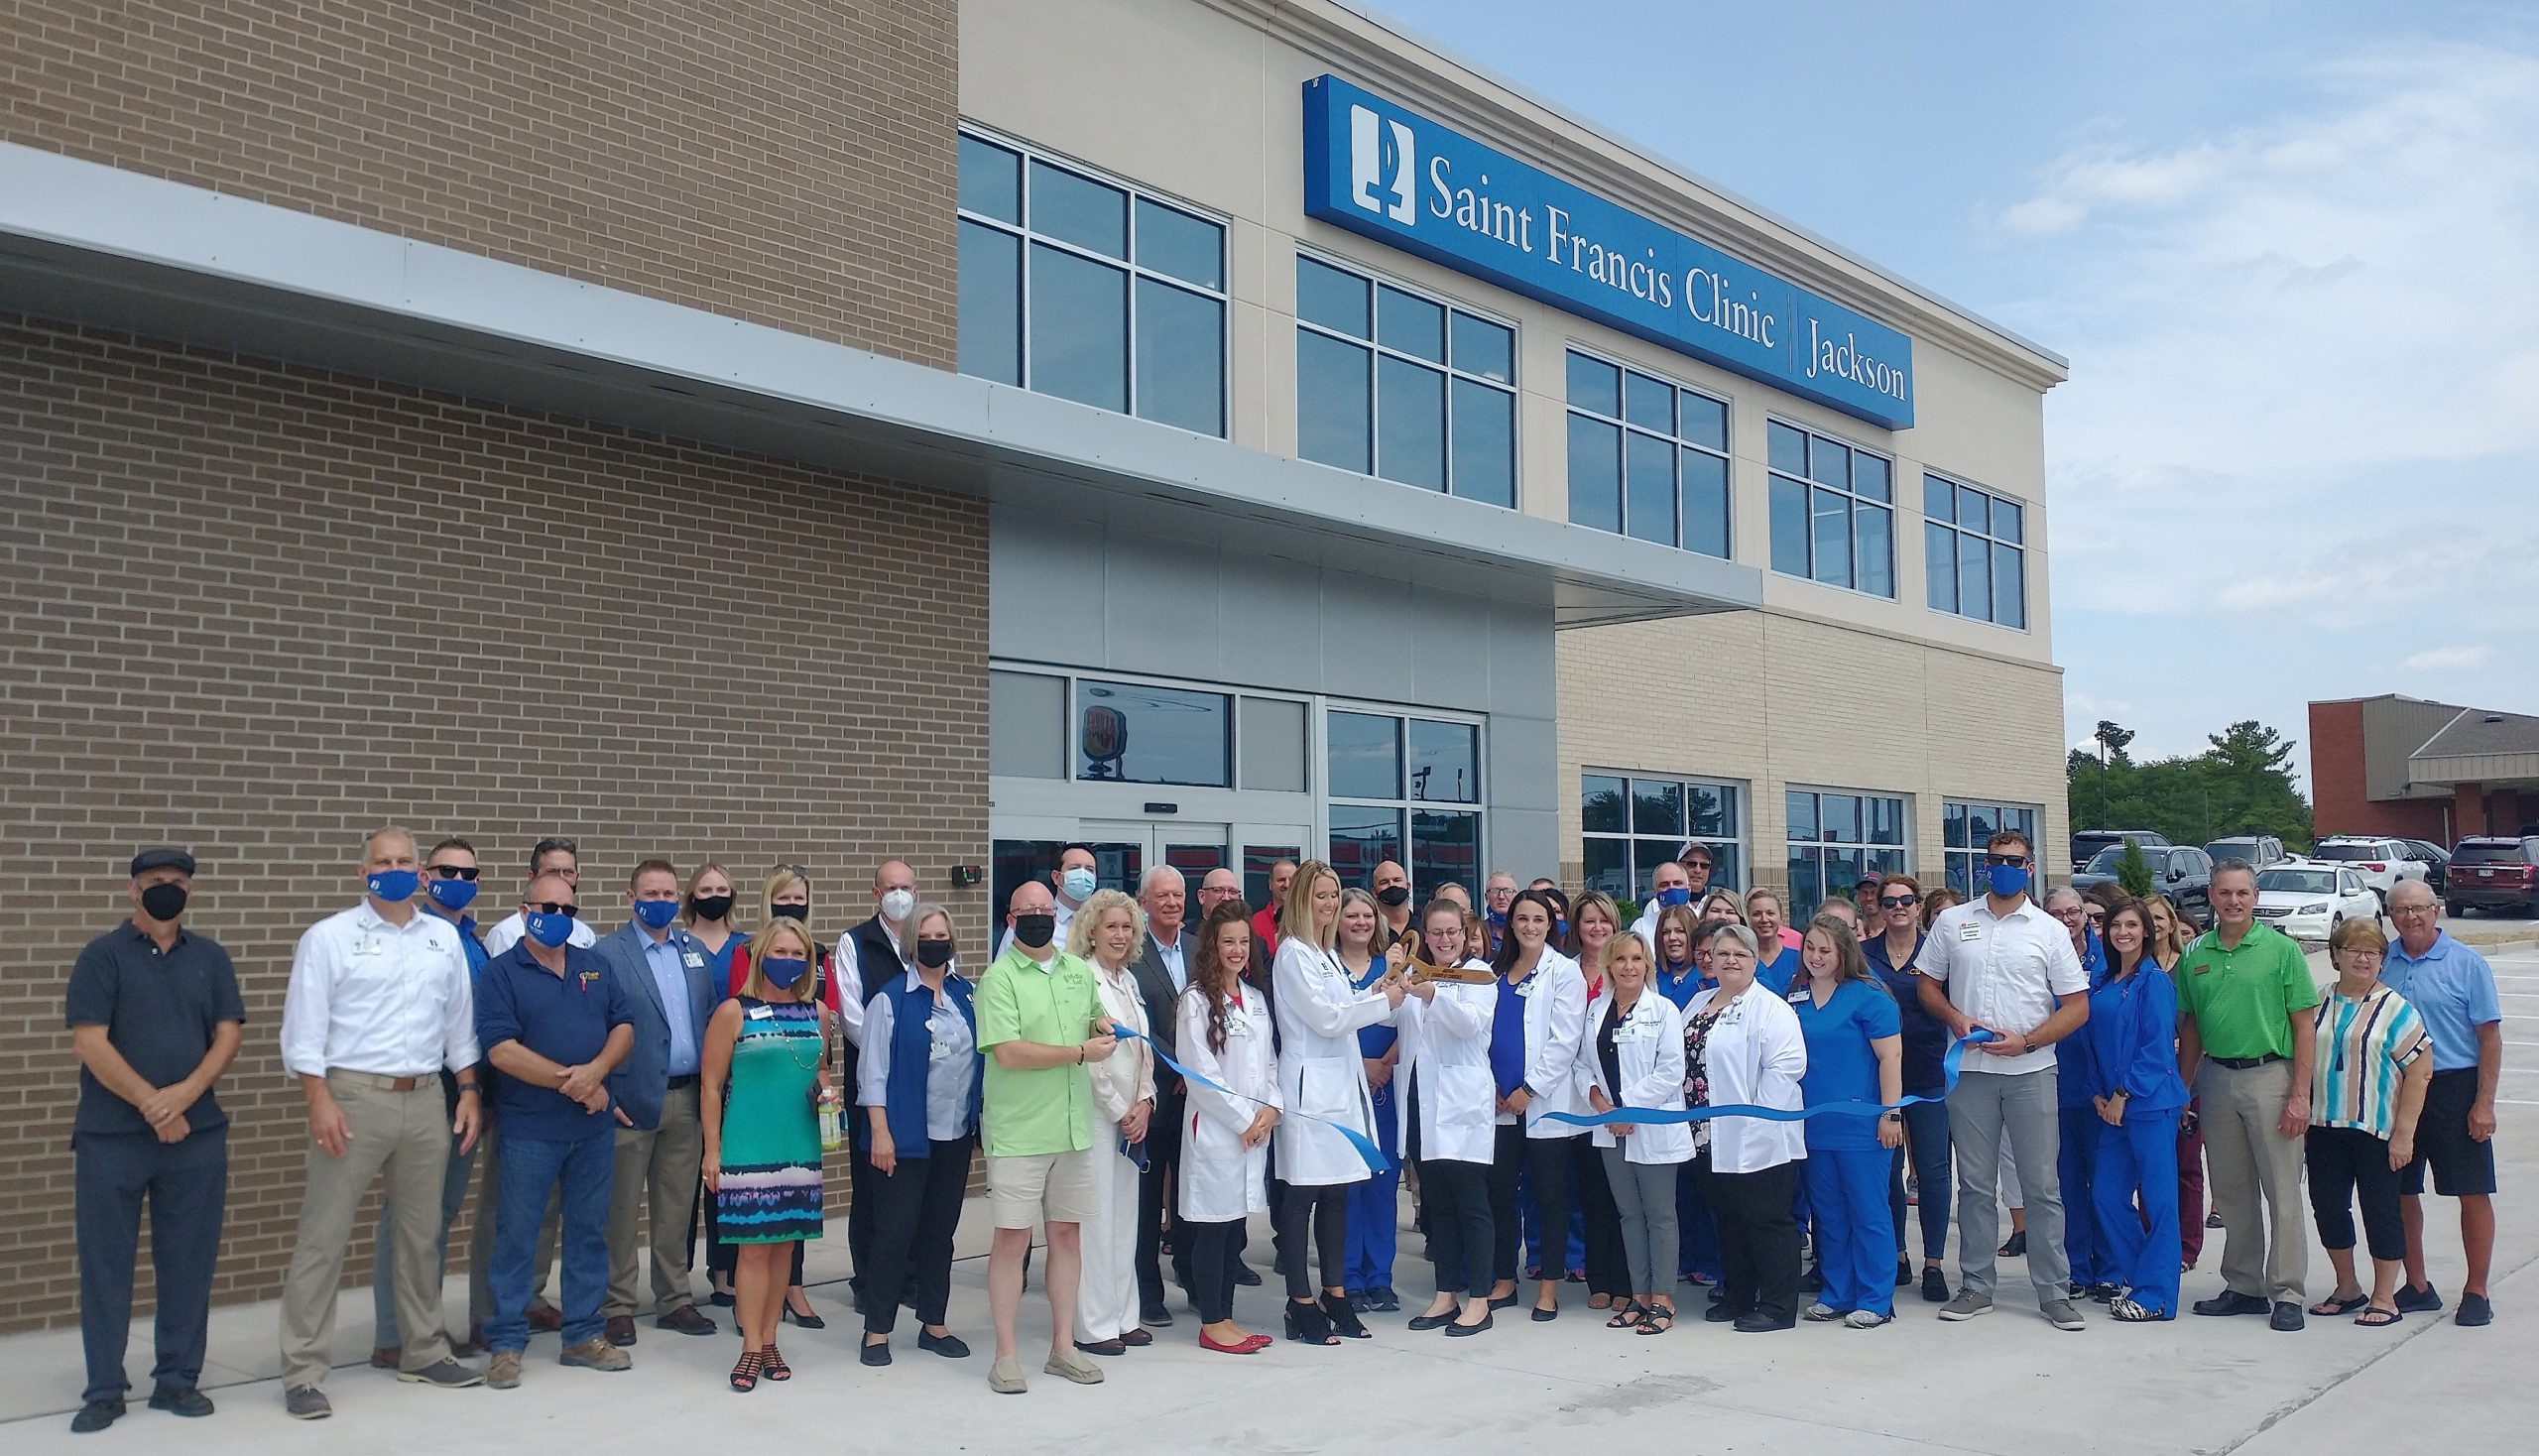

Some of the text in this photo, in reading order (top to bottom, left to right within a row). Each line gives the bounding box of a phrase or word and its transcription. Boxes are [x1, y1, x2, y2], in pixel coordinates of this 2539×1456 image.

[1429, 156, 1907, 402] Saint Francis Clinic Jackson
